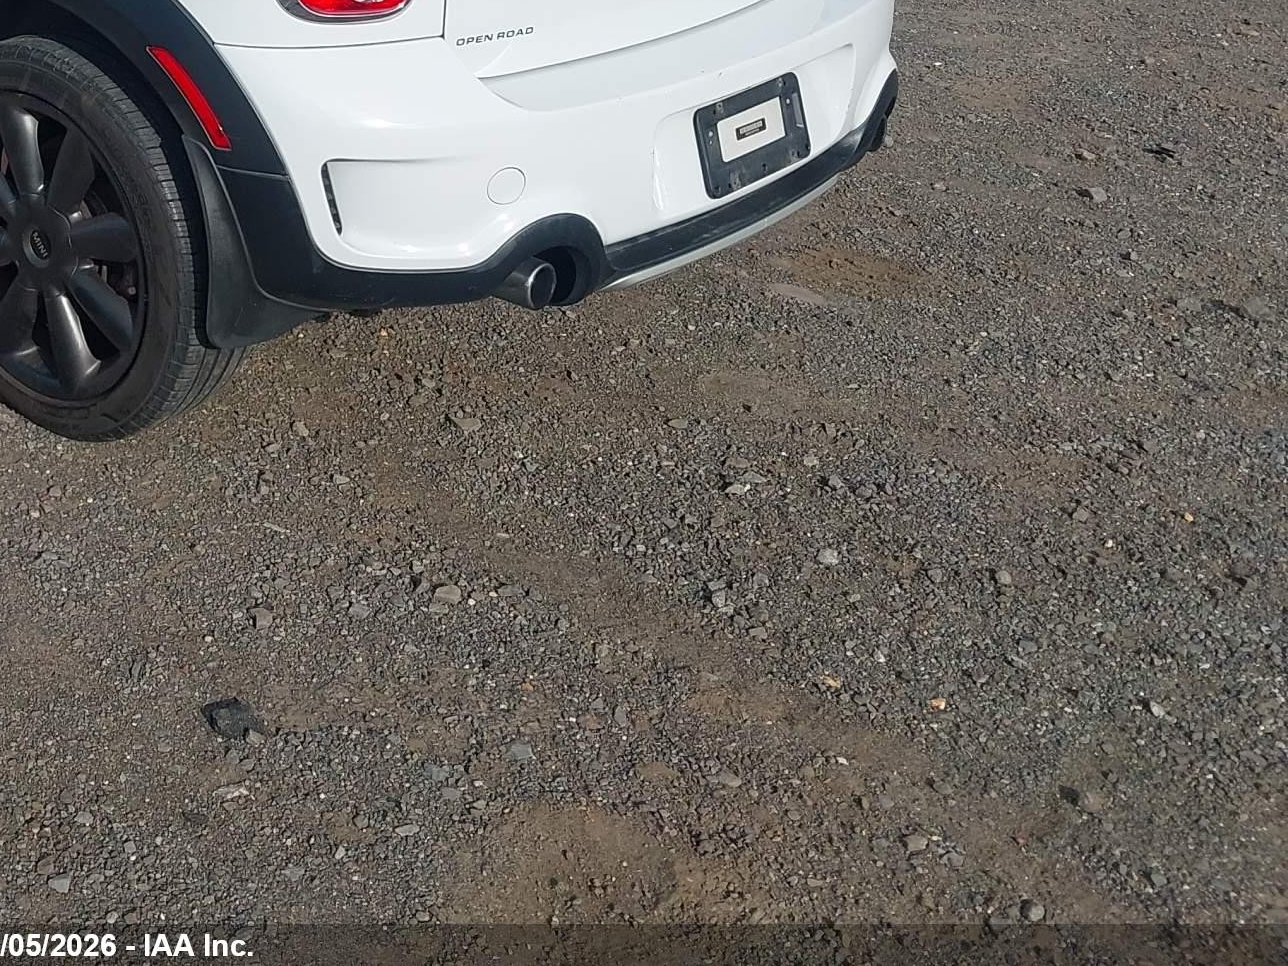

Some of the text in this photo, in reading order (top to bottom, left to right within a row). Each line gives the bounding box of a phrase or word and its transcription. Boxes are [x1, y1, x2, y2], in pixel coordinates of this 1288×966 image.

[456, 26, 534, 46] OPEN ROAD
[32, 231, 49, 258] MINI
